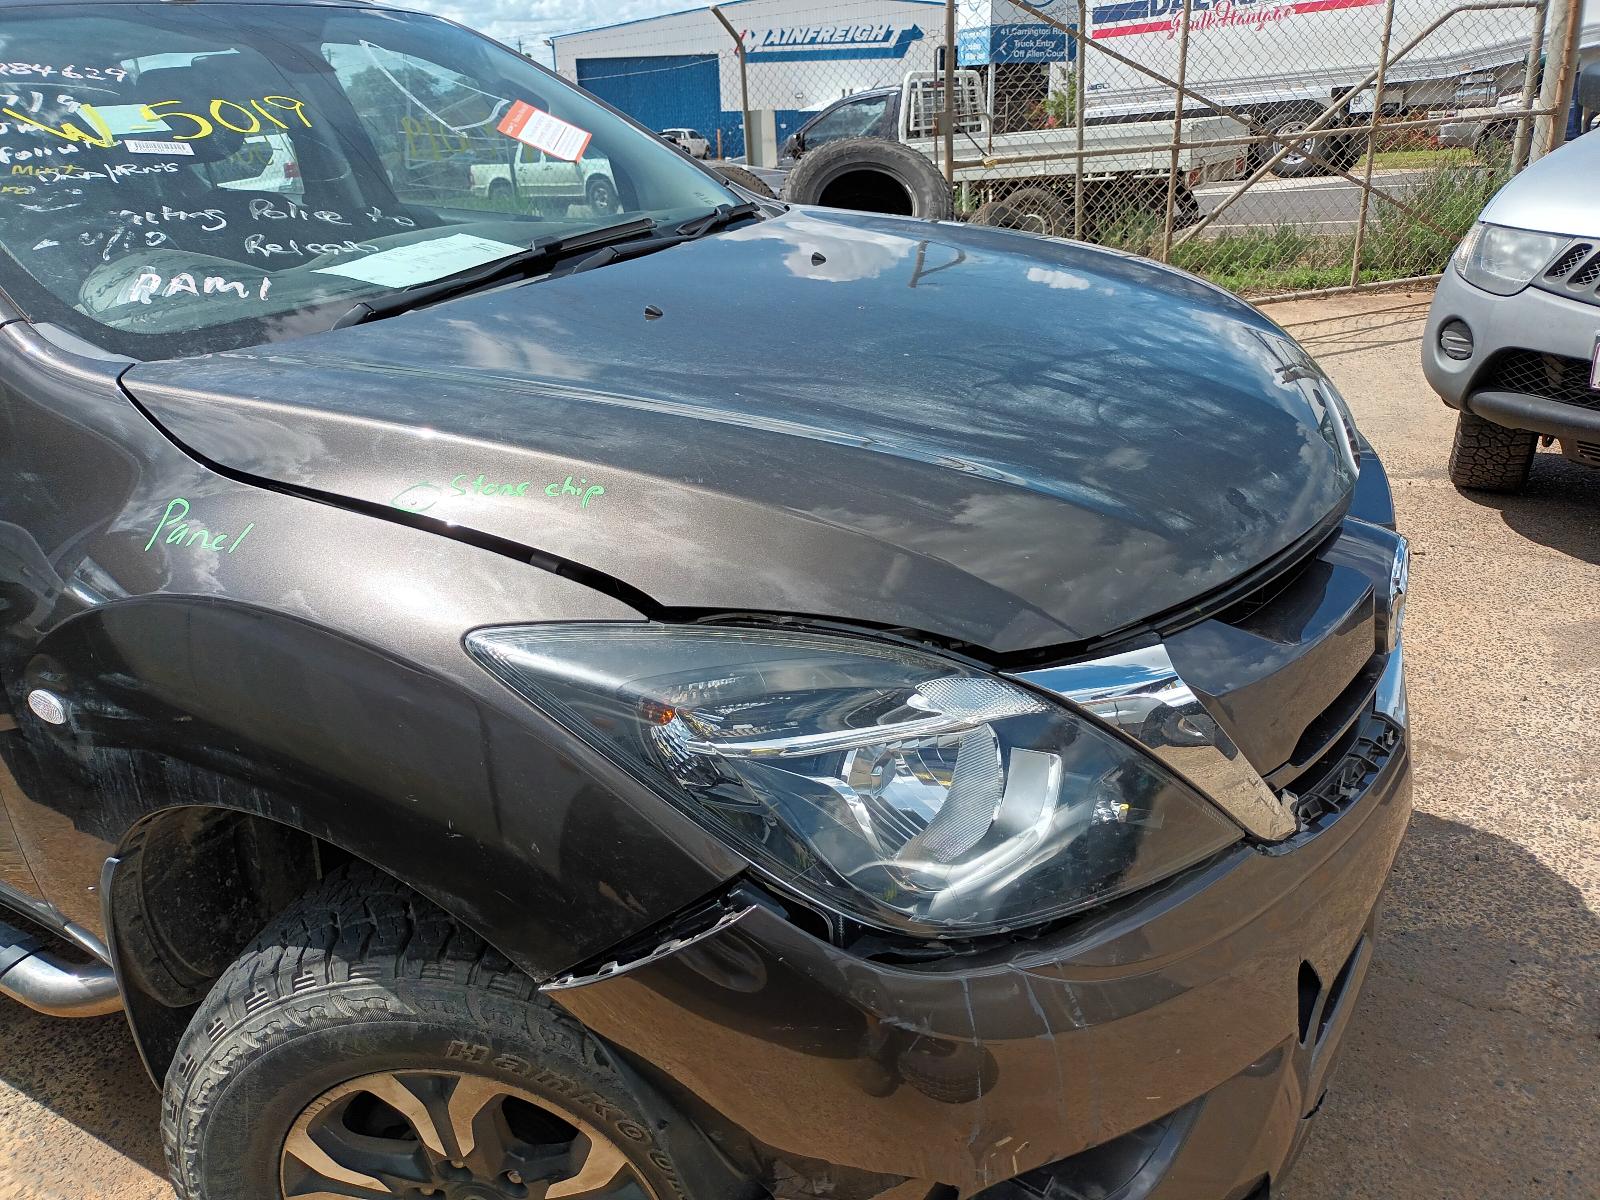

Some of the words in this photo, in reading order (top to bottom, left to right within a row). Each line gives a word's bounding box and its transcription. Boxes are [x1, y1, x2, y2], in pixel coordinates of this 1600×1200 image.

[743, 23, 907, 52] MAINFREIGHT
[1014, 39, 1034, 48] Truck
[1036, 39, 1057, 49] Entry
[1013, 49, 1025, 58] Off
[1026, 49, 1045, 58] Allen
[544, 476, 605, 509] chip
[144, 497, 255, 554] Panel
